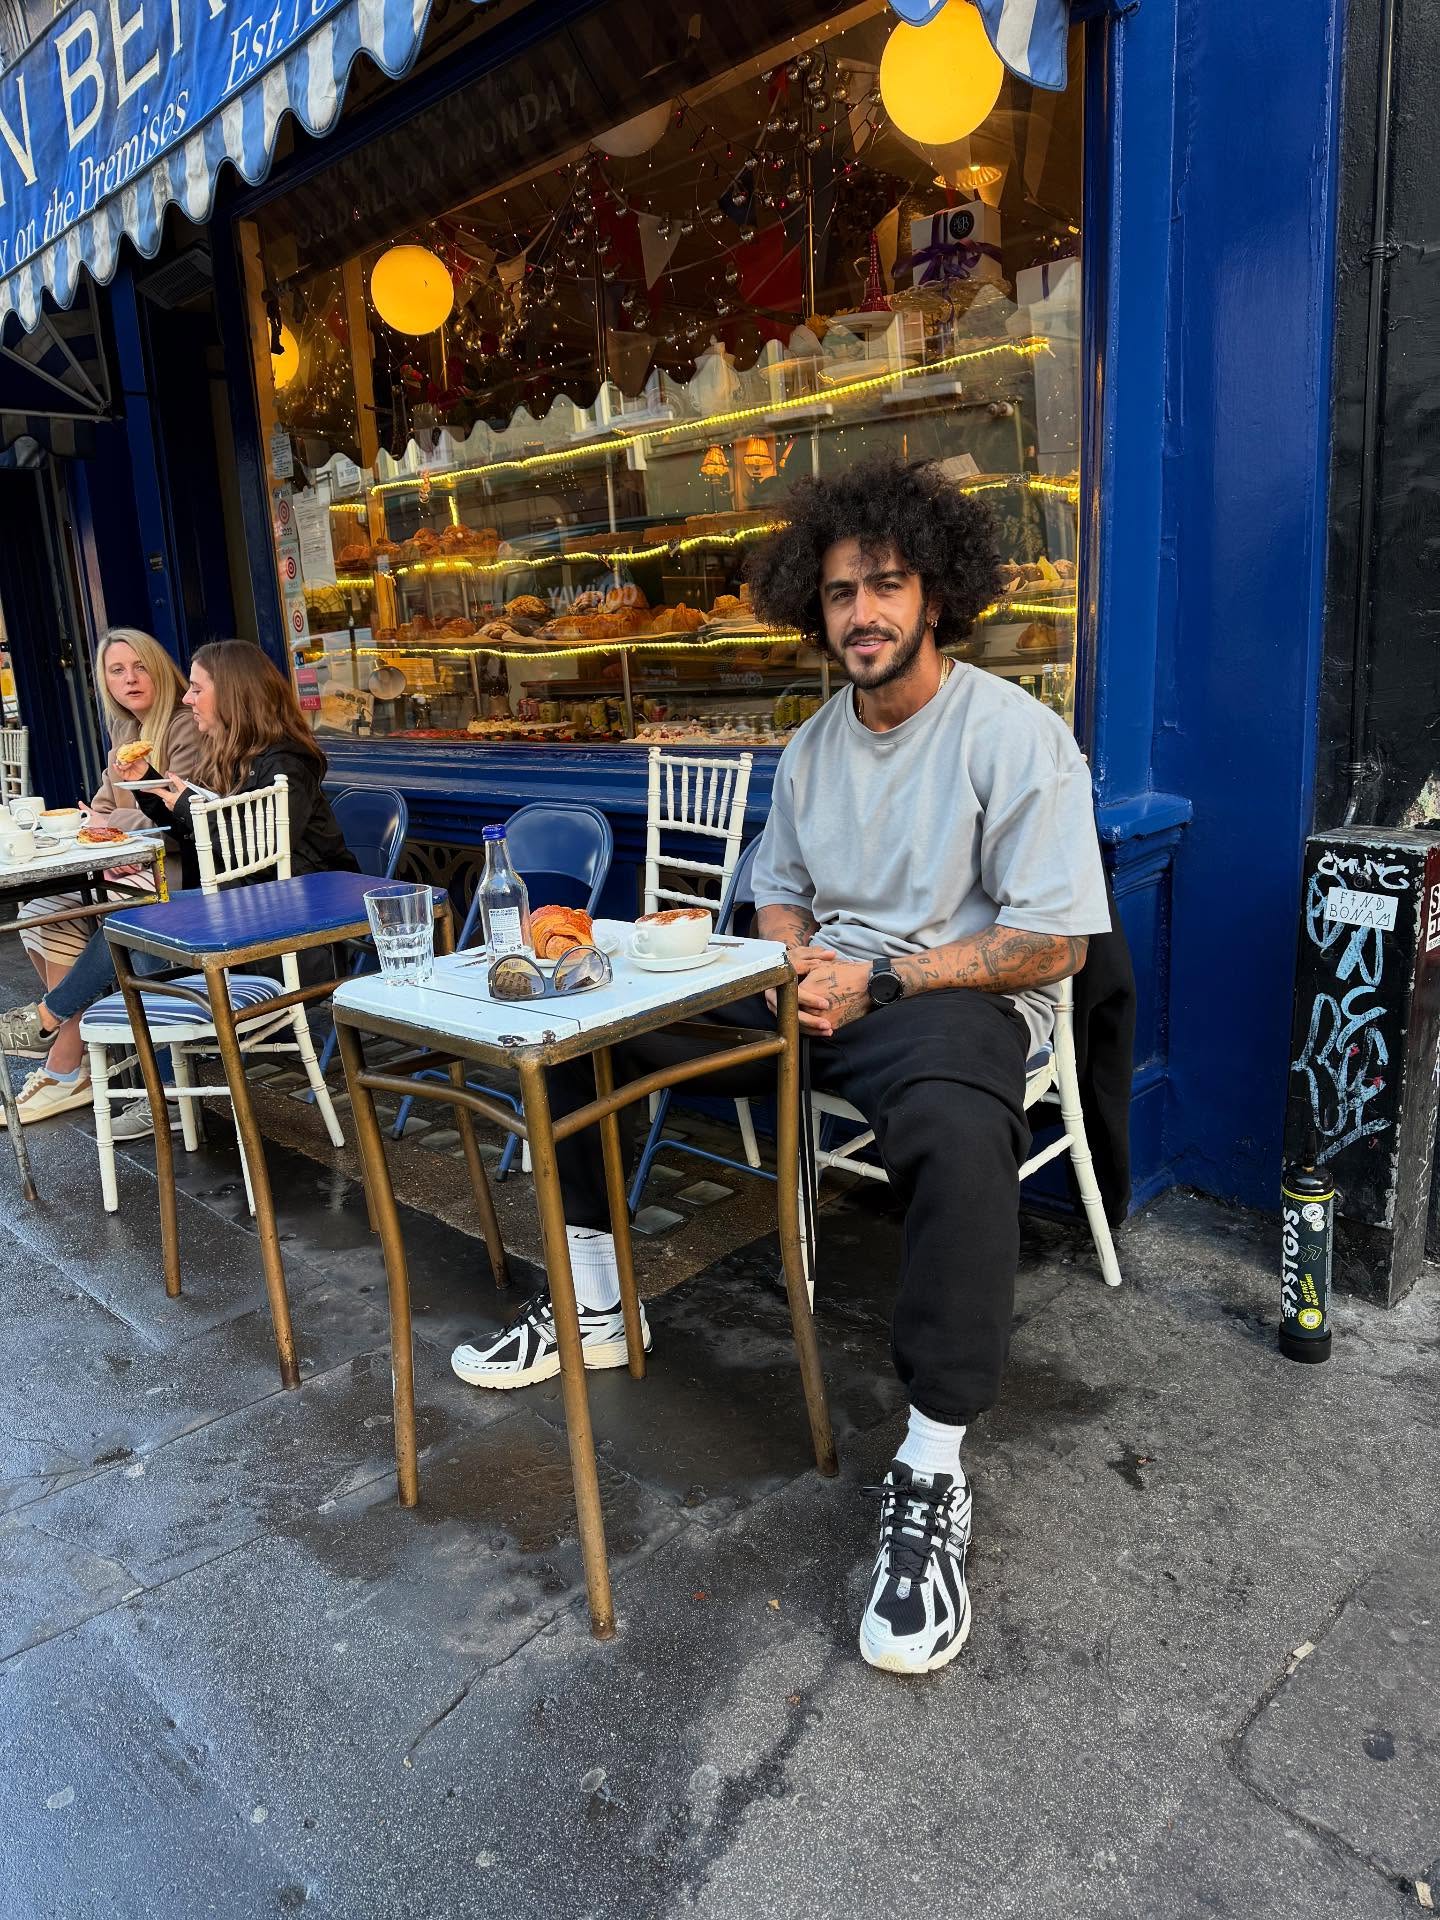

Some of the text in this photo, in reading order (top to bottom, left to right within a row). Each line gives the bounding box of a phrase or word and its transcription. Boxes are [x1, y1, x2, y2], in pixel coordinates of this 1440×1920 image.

[15, 219, 37, 263] on
[43, 188, 75, 240] the
[79, 88, 190, 215] Premises
[222, 0, 283, 96] Est.
[459, 66, 580, 167] MONDAY
